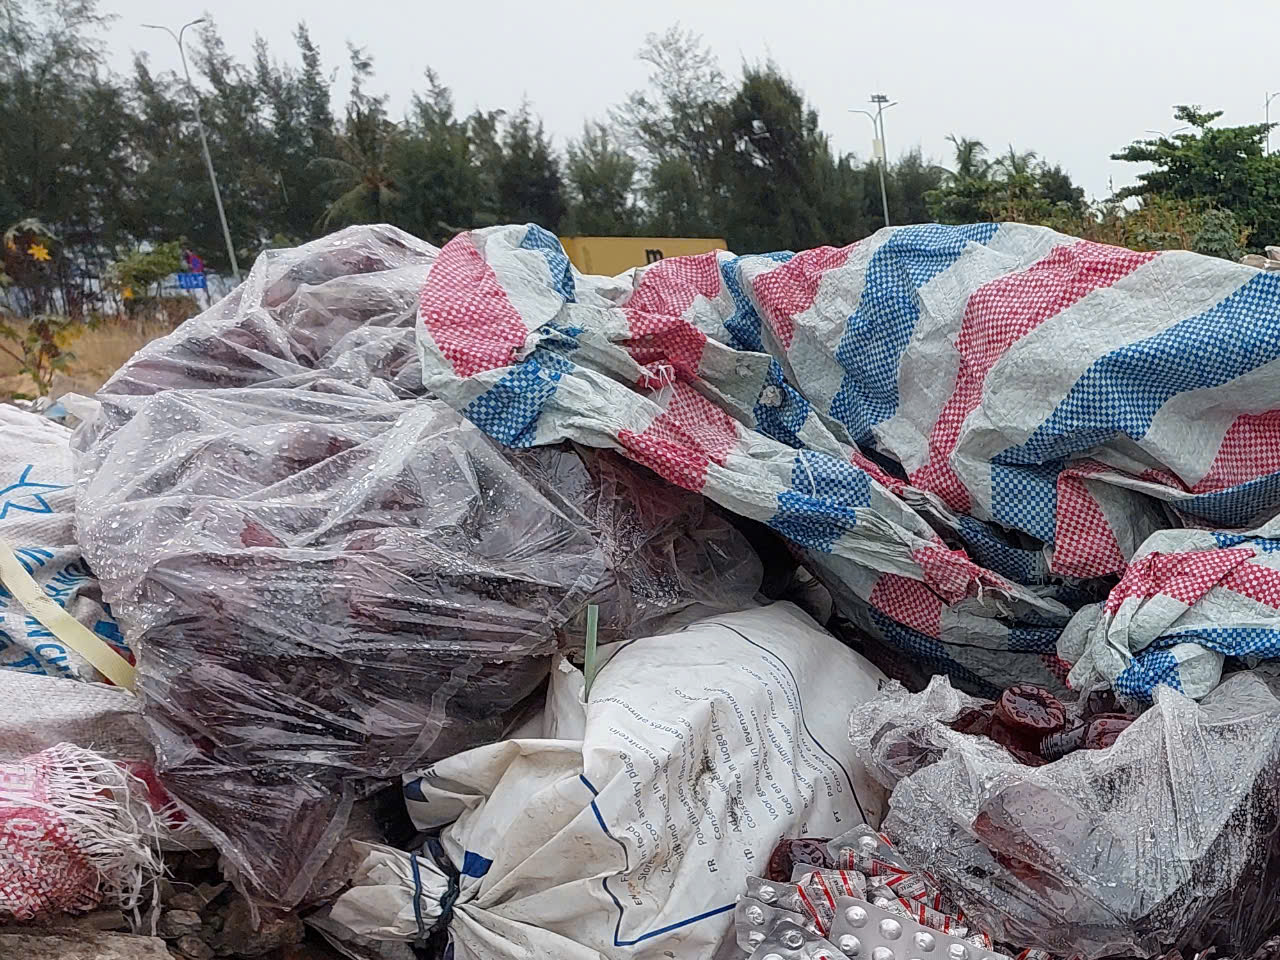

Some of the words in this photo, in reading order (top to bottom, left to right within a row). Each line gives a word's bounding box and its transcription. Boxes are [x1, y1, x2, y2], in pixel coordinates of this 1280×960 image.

[715, 733, 732, 764] luogo
[619, 750, 640, 780] place.
[632, 780, 642, 799] dry
[770, 782, 782, 794] en
[823, 775, 834, 798] Para
[634, 800, 646, 820] and
[761, 799, 779, 821] Voor
[779, 794, 794, 816] Koel
[832, 810, 842, 823] PT
[638, 858, 655, 881] Store
[707, 858, 719, 873] FR
[628, 894, 643, 906] EN
